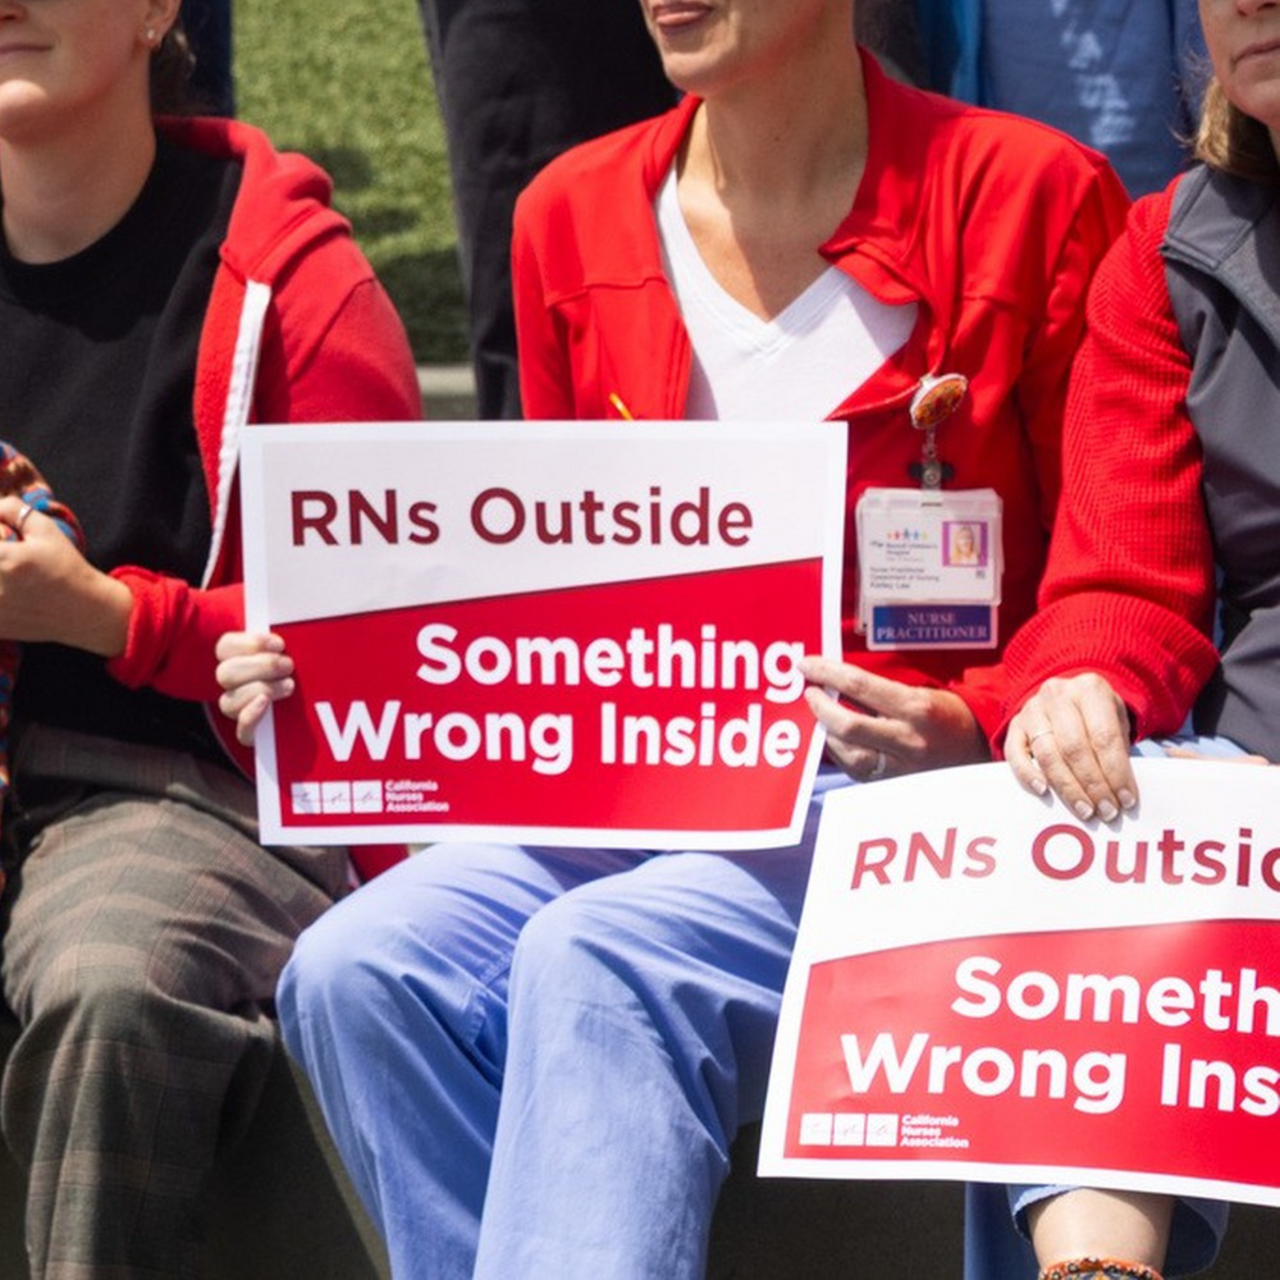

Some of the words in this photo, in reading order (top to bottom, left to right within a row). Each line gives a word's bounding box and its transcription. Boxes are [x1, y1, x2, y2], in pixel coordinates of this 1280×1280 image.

[290, 487, 441, 548] RNs
[469, 485, 755, 548] Outside
[907, 611, 957, 625] NURSE
[876, 625, 989, 640] PRACTITIONER
[416, 623, 807, 703] Something
[315, 700, 574, 776] Wrong
[601, 702, 801, 768] Inside
[384, 779, 439, 792] California
[384, 792, 424, 803] Nurses
[385, 802, 451, 813] Association
[850, 826, 999, 891] RNs
[1030, 823, 1280, 894] Outsi
[950, 955, 1280, 1038] Someth
[840, 1032, 1128, 1116] Wrong
[1160, 1043, 1280, 1118] Ins
[901, 1113, 960, 1127] California
[900, 1126, 942, 1137] Nurses
[899, 1136, 970, 1149] Association
